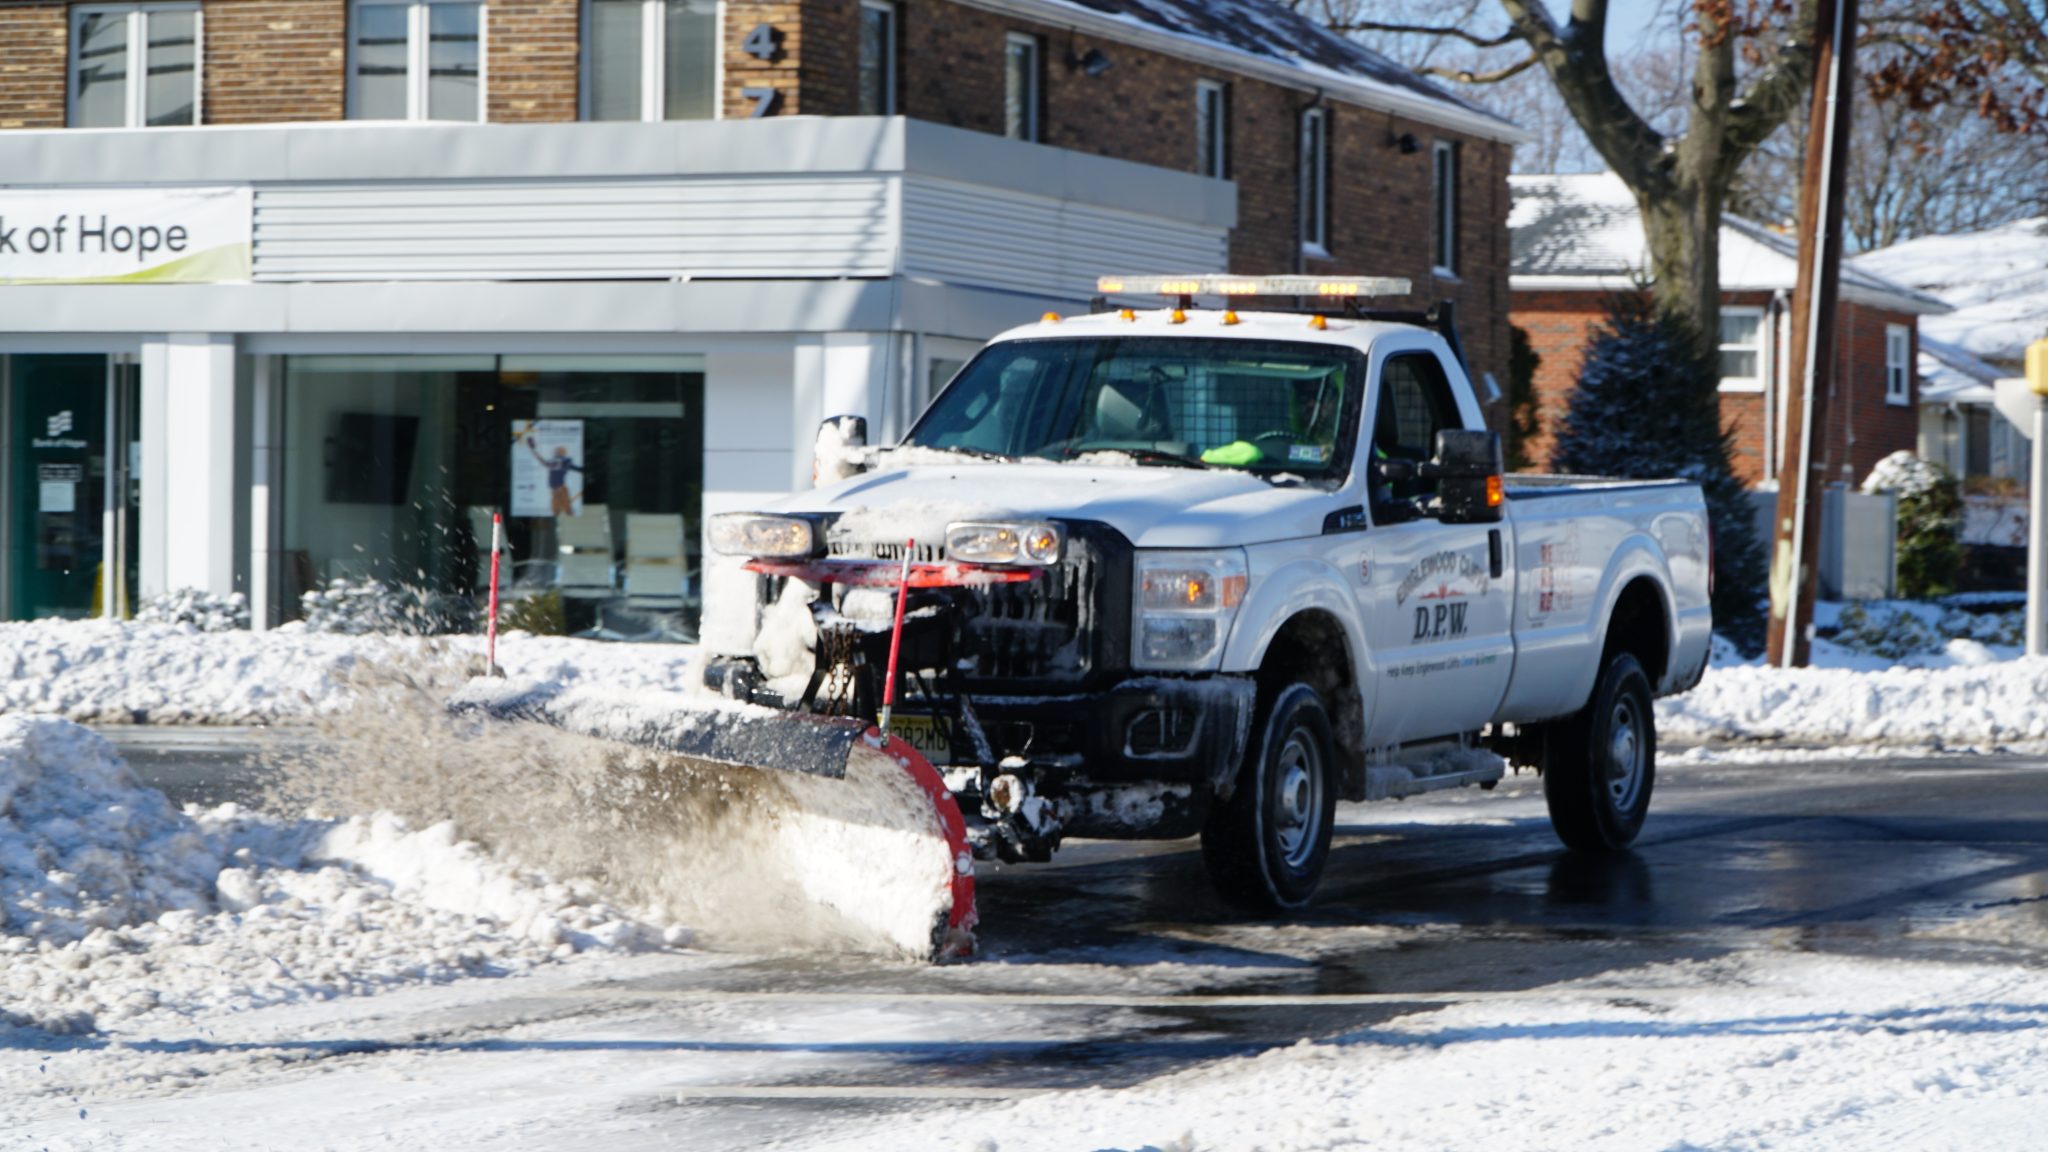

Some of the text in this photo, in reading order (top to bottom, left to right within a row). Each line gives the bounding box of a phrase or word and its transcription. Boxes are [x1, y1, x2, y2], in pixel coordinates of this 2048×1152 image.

[742, 23, 776, 59] 4
[742, 87, 775, 117] 7
[28, 215, 67, 253] of
[79, 215, 188, 262] Hope
[1413, 601, 1469, 640] D.P.W.
